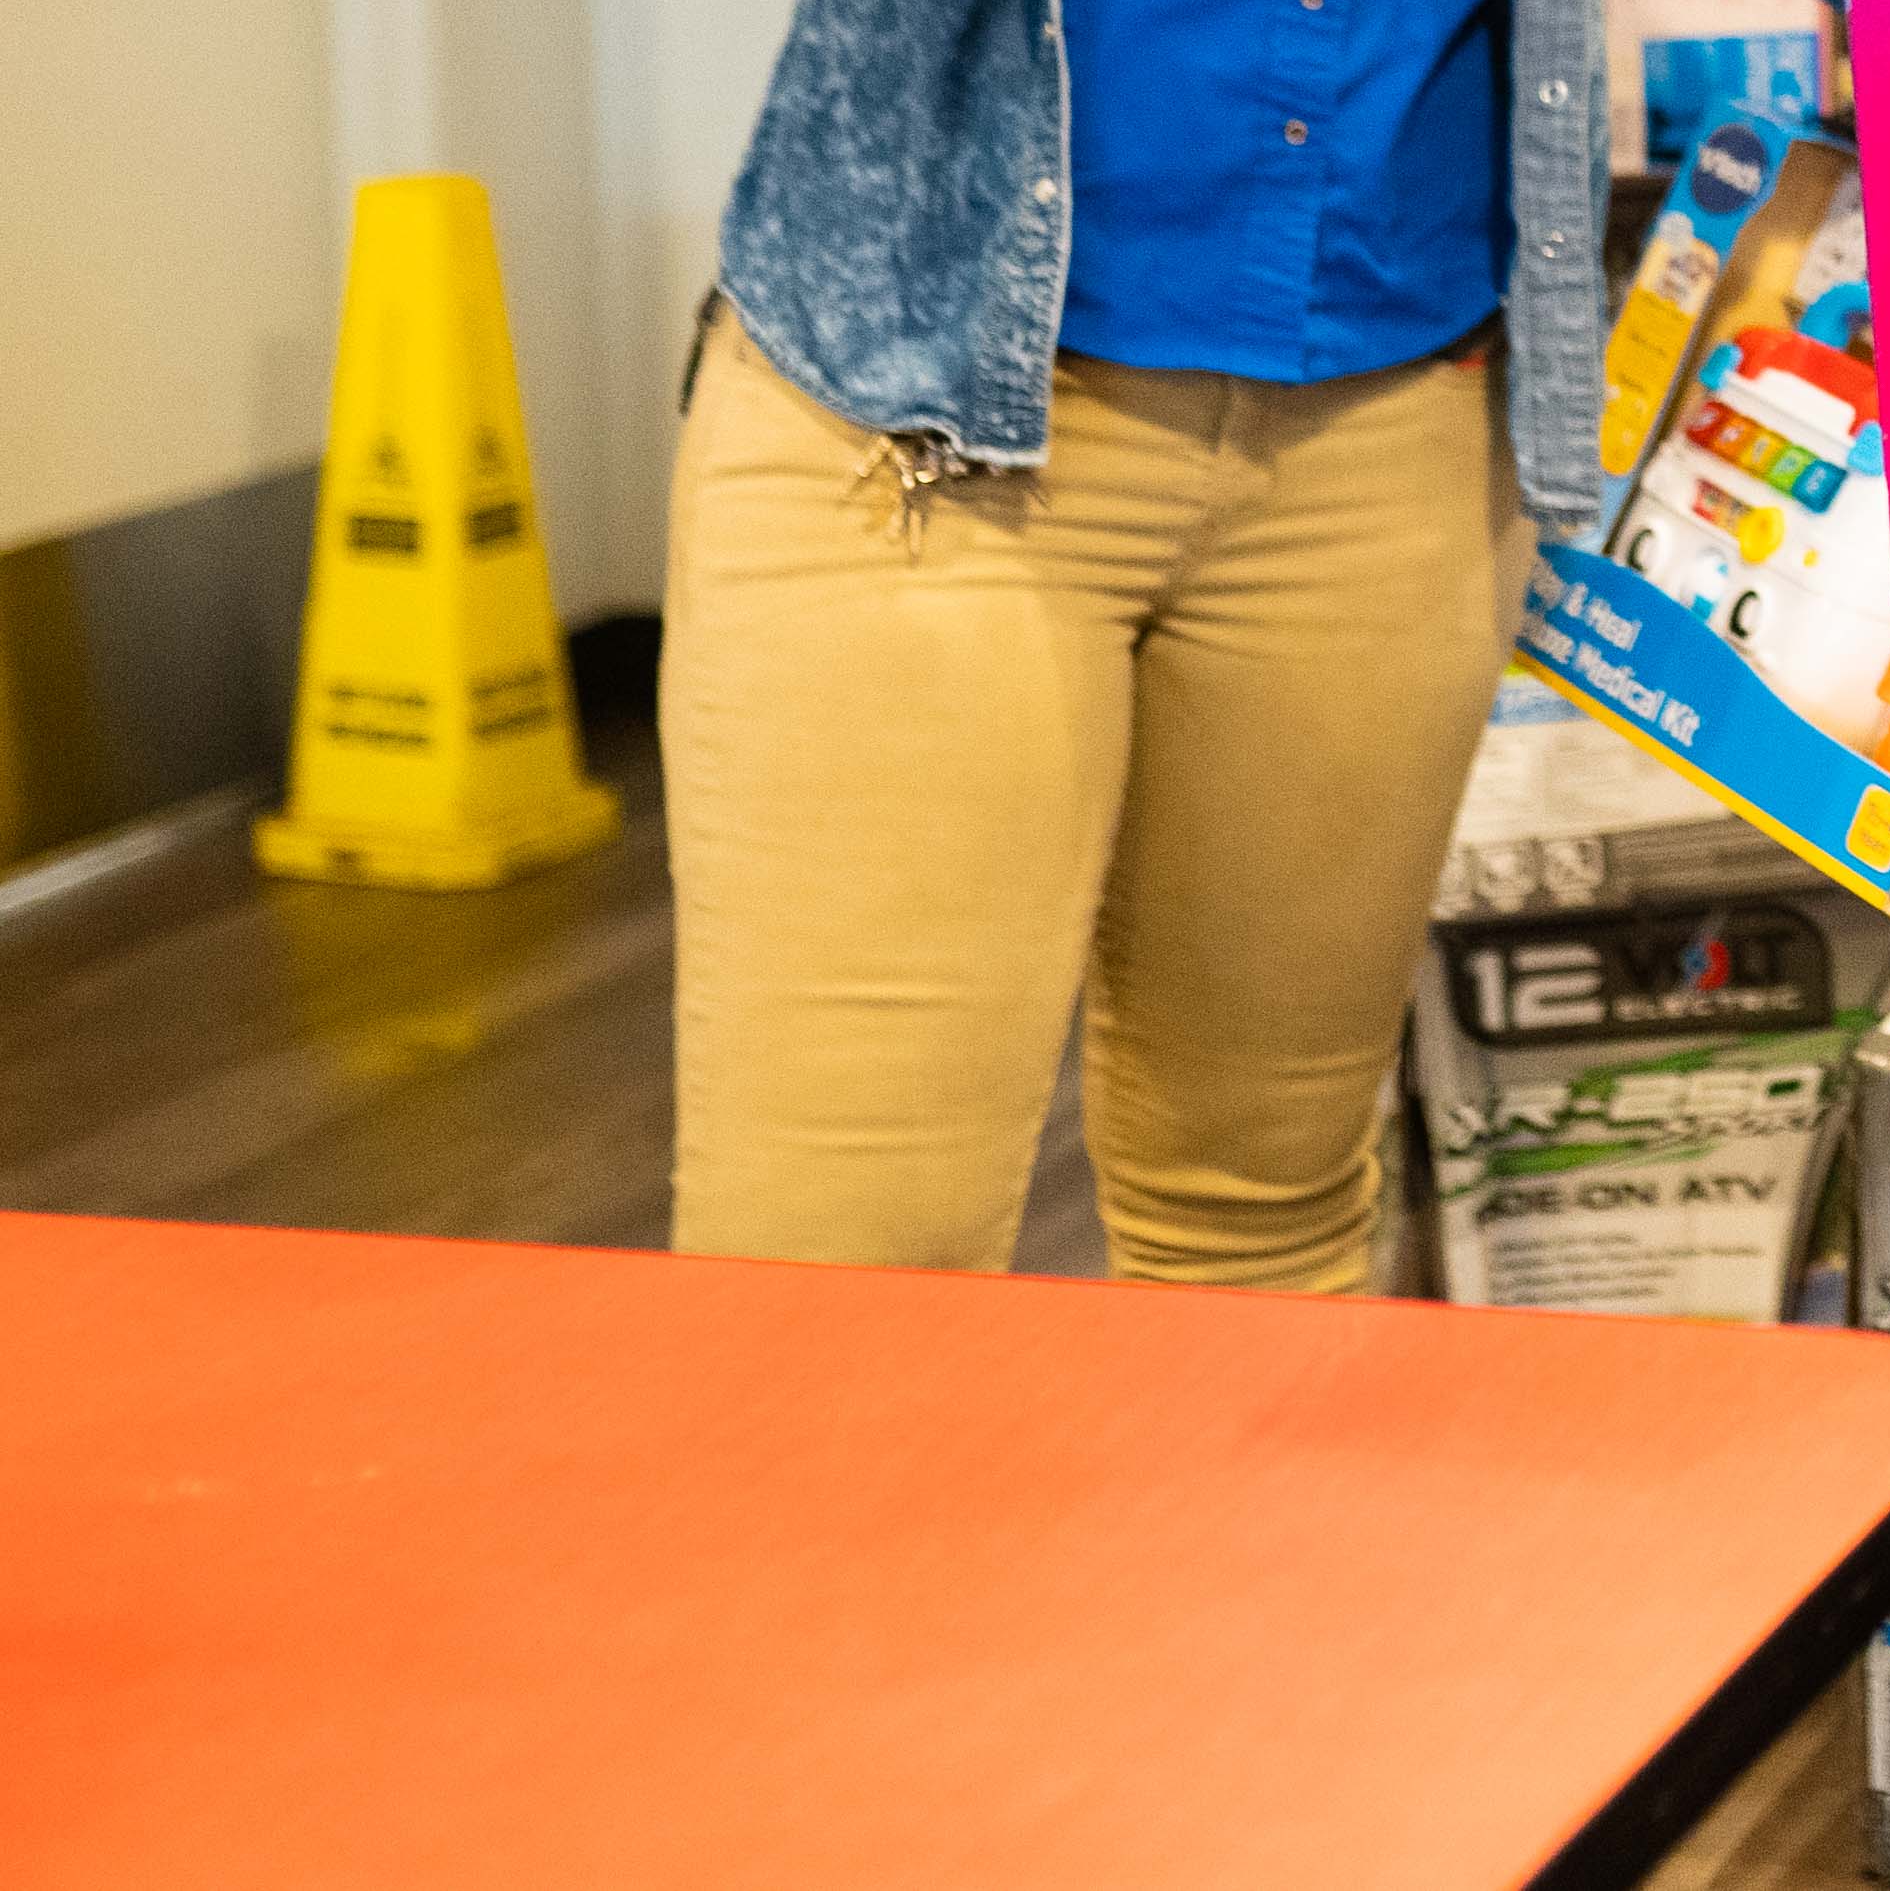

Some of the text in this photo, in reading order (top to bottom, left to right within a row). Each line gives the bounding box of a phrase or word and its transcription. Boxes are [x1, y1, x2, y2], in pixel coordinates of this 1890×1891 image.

[1575, 641, 1667, 723] Medical
[1660, 695, 1701, 746] Kit
[1467, 943, 1606, 1032] 12
